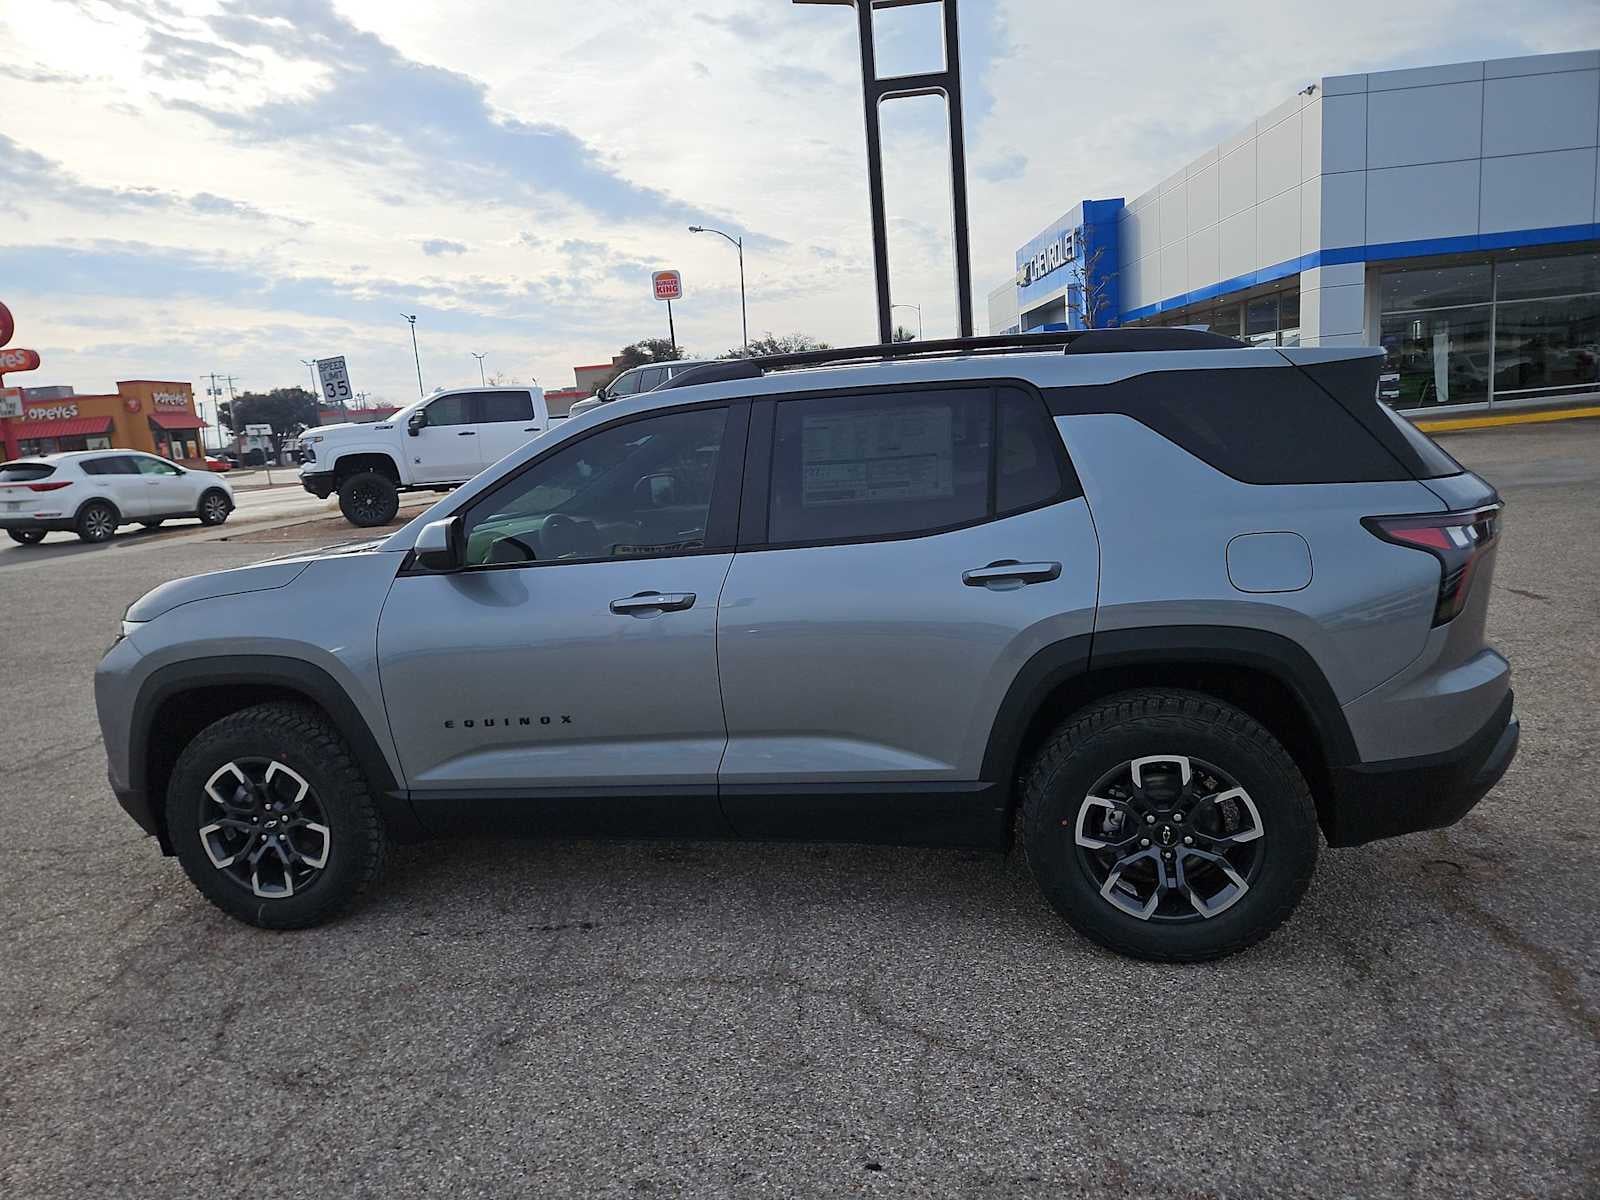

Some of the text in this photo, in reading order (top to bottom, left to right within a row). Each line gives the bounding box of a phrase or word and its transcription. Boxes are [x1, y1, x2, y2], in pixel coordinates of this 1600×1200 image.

[1030, 227, 1079, 281] CHEVROLET
[656, 285, 678, 293] KING
[319, 361, 345, 370] SPEED
[323, 370, 344, 381] LIMIT
[326, 380, 348, 398] 35
[444, 715, 572, 728] EQUINOX
